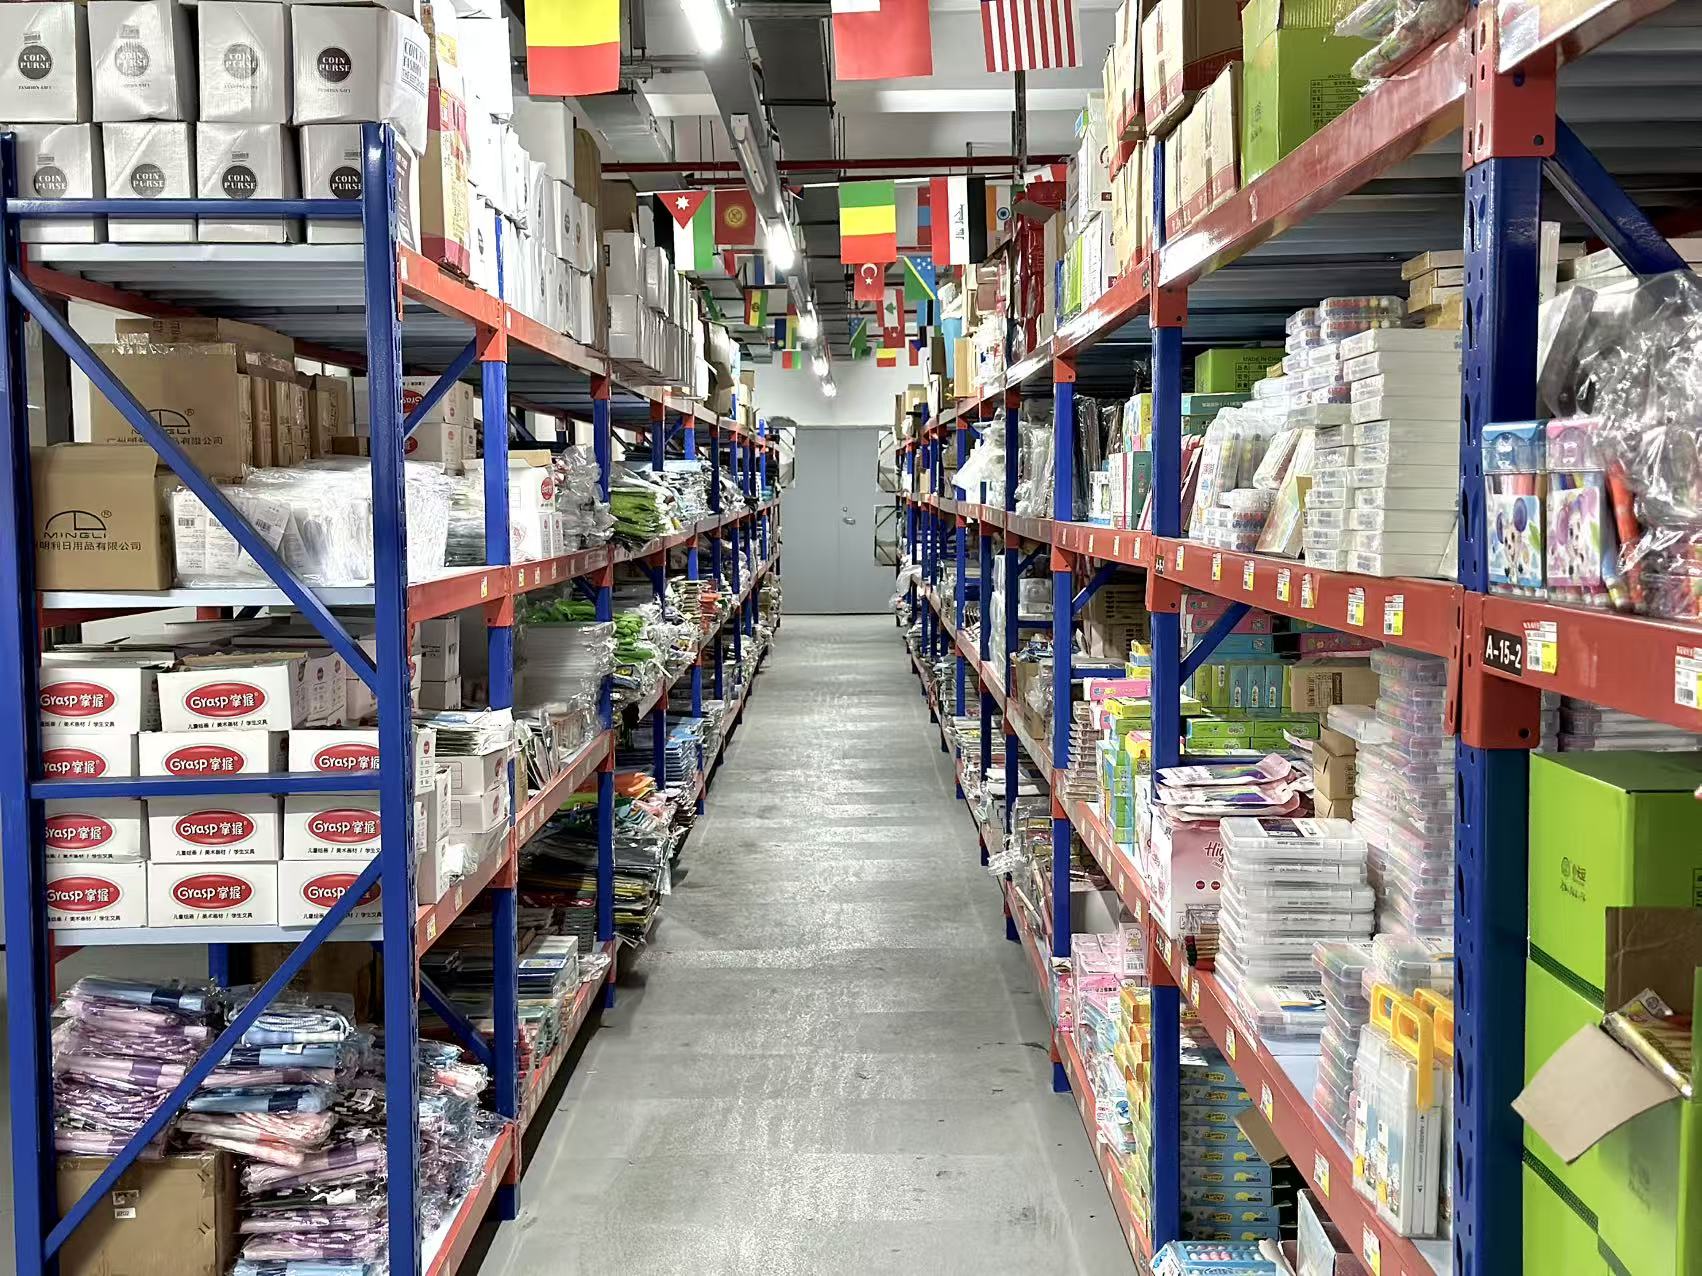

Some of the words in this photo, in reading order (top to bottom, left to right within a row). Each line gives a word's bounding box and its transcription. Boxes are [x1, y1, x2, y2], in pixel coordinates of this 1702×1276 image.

[36, 541, 141, 551] 明利日用品有限公司
[1486, 635, 1521, 669] A-15-2
[40, 694, 78, 707] Grasp
[80, 694, 104, 707] 掌握
[190, 696, 228, 708] Grasp
[230, 694, 254, 707] 掌握
[44, 762, 70, 773] rasp
[72, 760, 95, 774] 掌握
[170, 758, 208, 771] Grasp
[210, 757, 234, 770] 掌握
[319, 756, 356, 769] Grasp
[77, 826, 102, 839] 掌握
[181, 824, 218, 835] Grasp
[219, 822, 243, 835] 掌握
[313, 821, 350, 834] Grasp
[352, 820, 376, 834] 掌握
[1204, 841, 1224, 863] Hig
[85, 888, 109, 902] 掌握
[178, 887, 215, 900] Grasp
[217, 886, 241, 899] 掌握
[308, 886, 345, 899] Grasp
